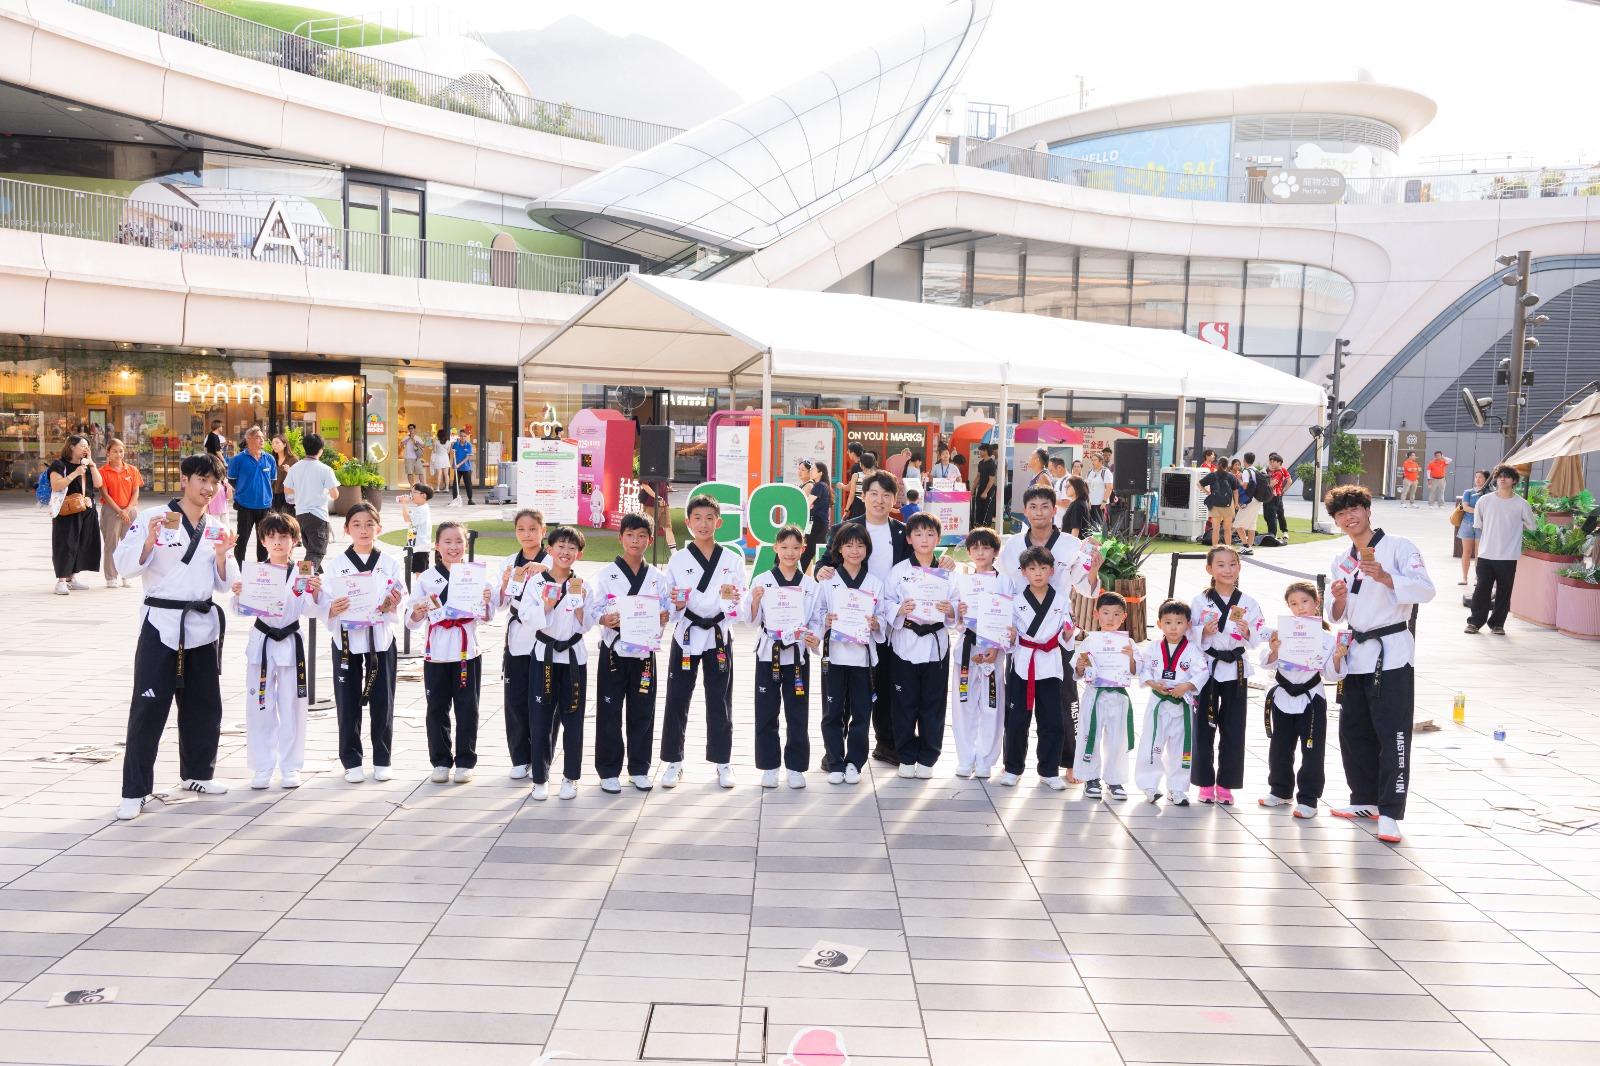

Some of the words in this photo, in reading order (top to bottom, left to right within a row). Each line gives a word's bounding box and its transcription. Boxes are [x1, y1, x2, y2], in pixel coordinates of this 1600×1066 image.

[252, 200, 305, 262] A
[1218, 324, 1225, 332] K
[195, 382, 264, 404] YATA
[847, 431, 861, 441] ON
[863, 431, 888, 441] YOUR
[686, 481, 811, 546] GO
[1396, 731, 1405, 768] MASTER
